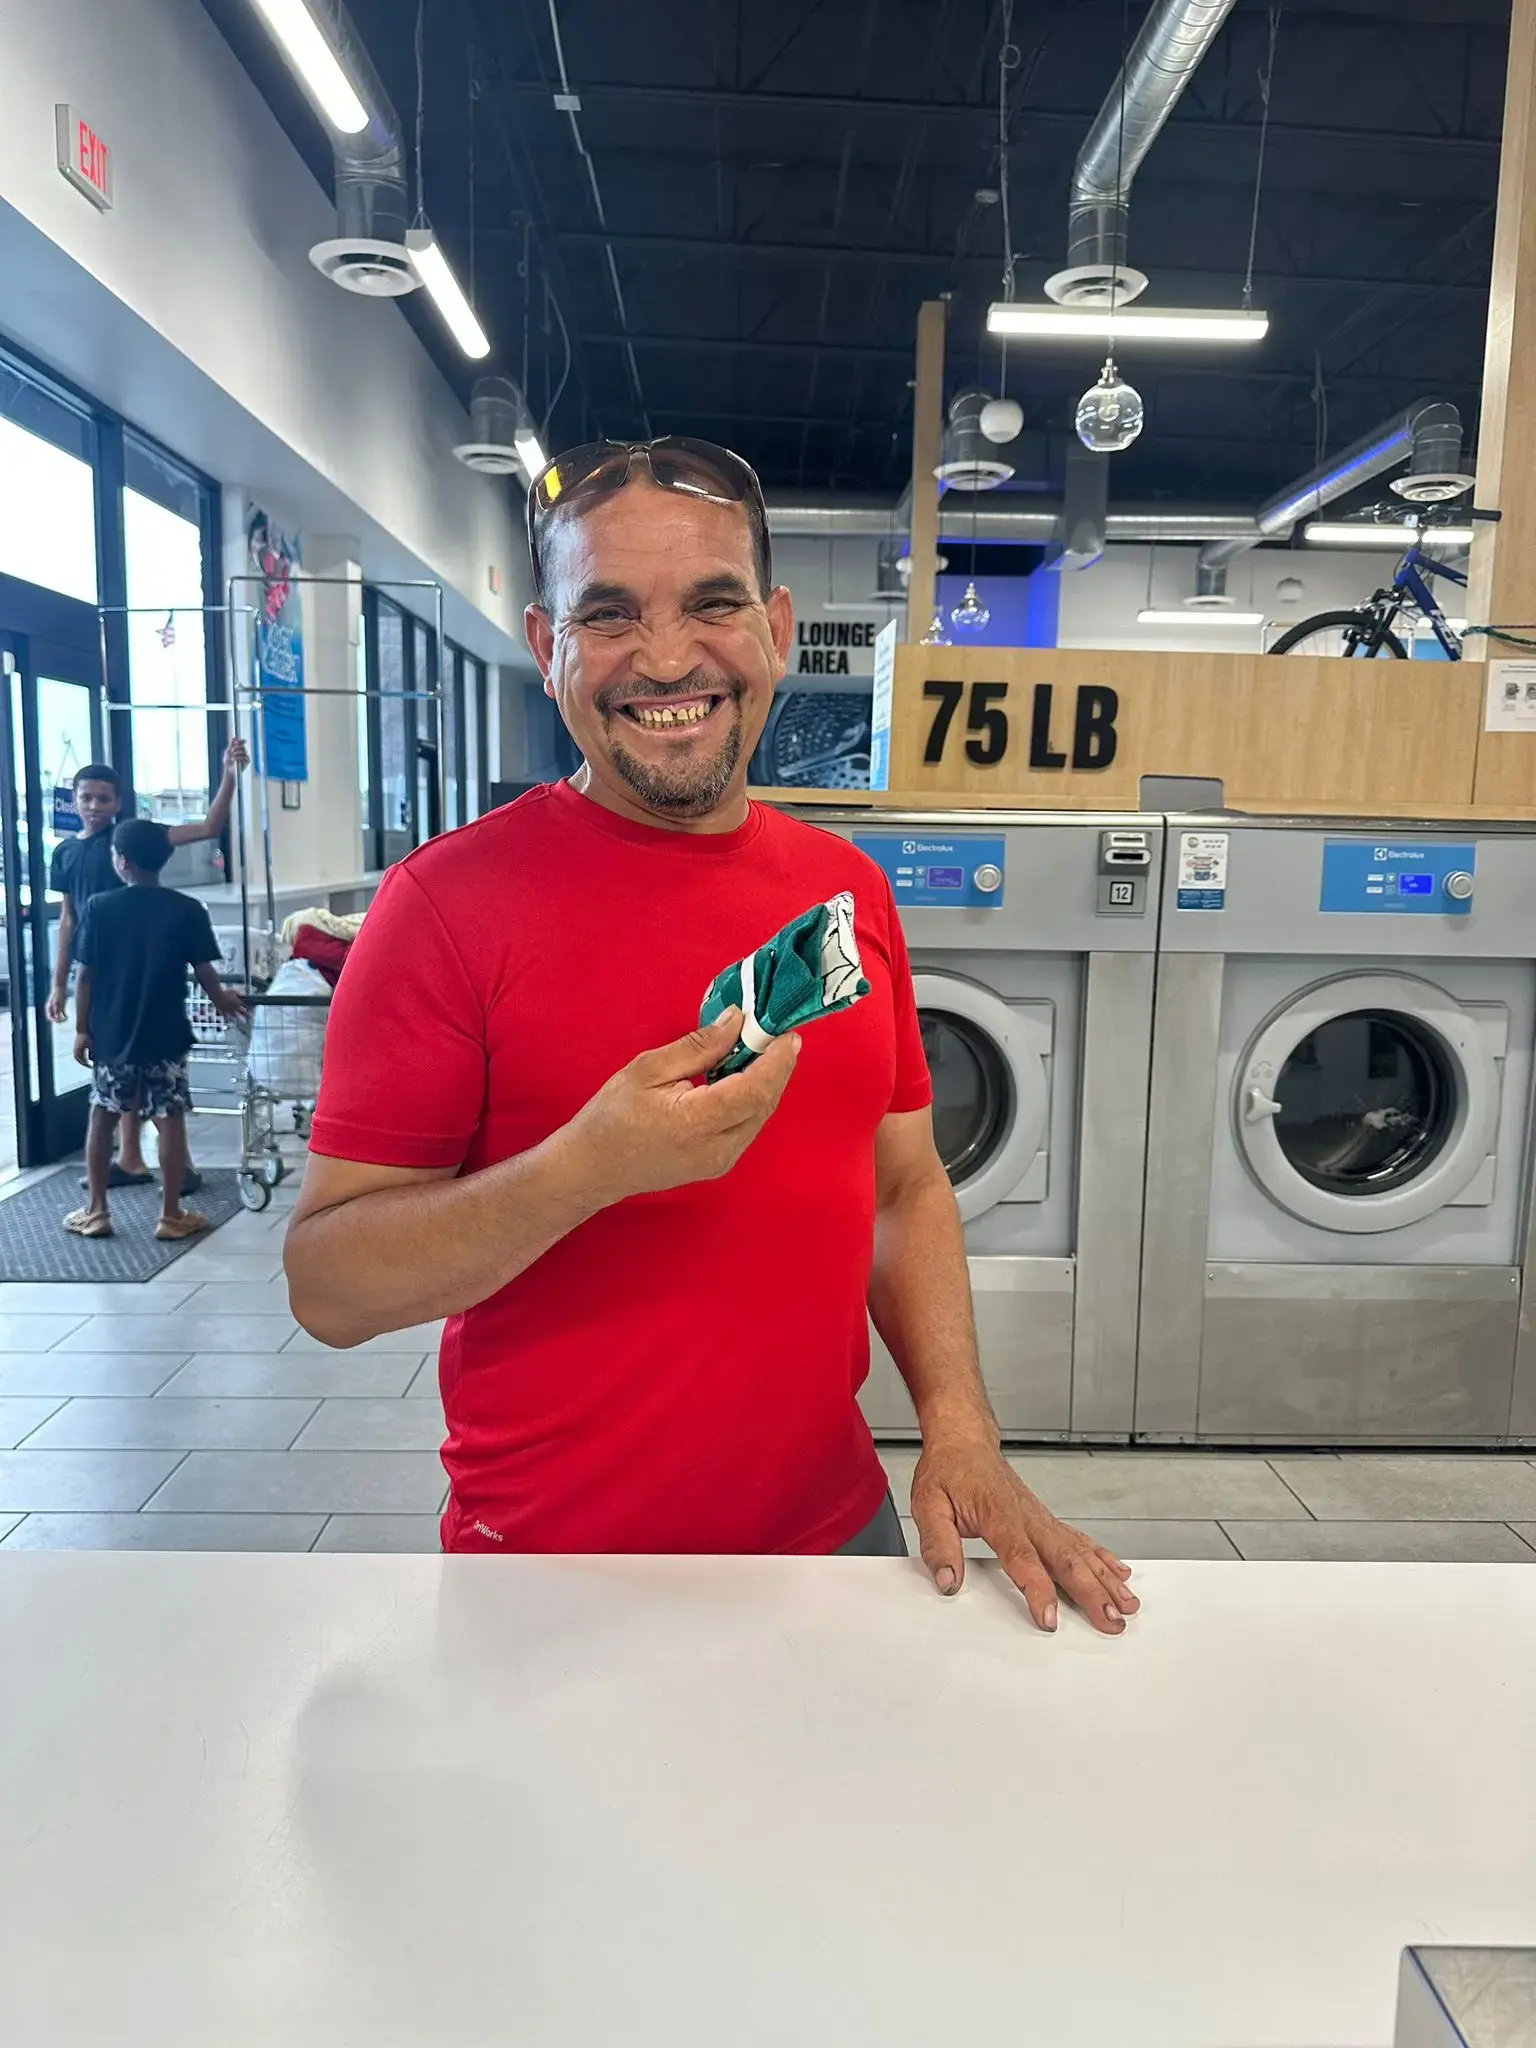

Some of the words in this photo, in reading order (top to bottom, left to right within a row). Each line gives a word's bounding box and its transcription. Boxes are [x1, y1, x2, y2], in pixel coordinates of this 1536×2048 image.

[79, 119, 107, 193] EXIT
[798, 621, 875, 647] LOUNGE
[798, 649, 849, 675] AREA
[923, 680, 1009, 766] 75
[1029, 684, 1119, 770] LB
[917, 843, 954, 852] Electrolux
[1115, 886, 1129, 900] 12
